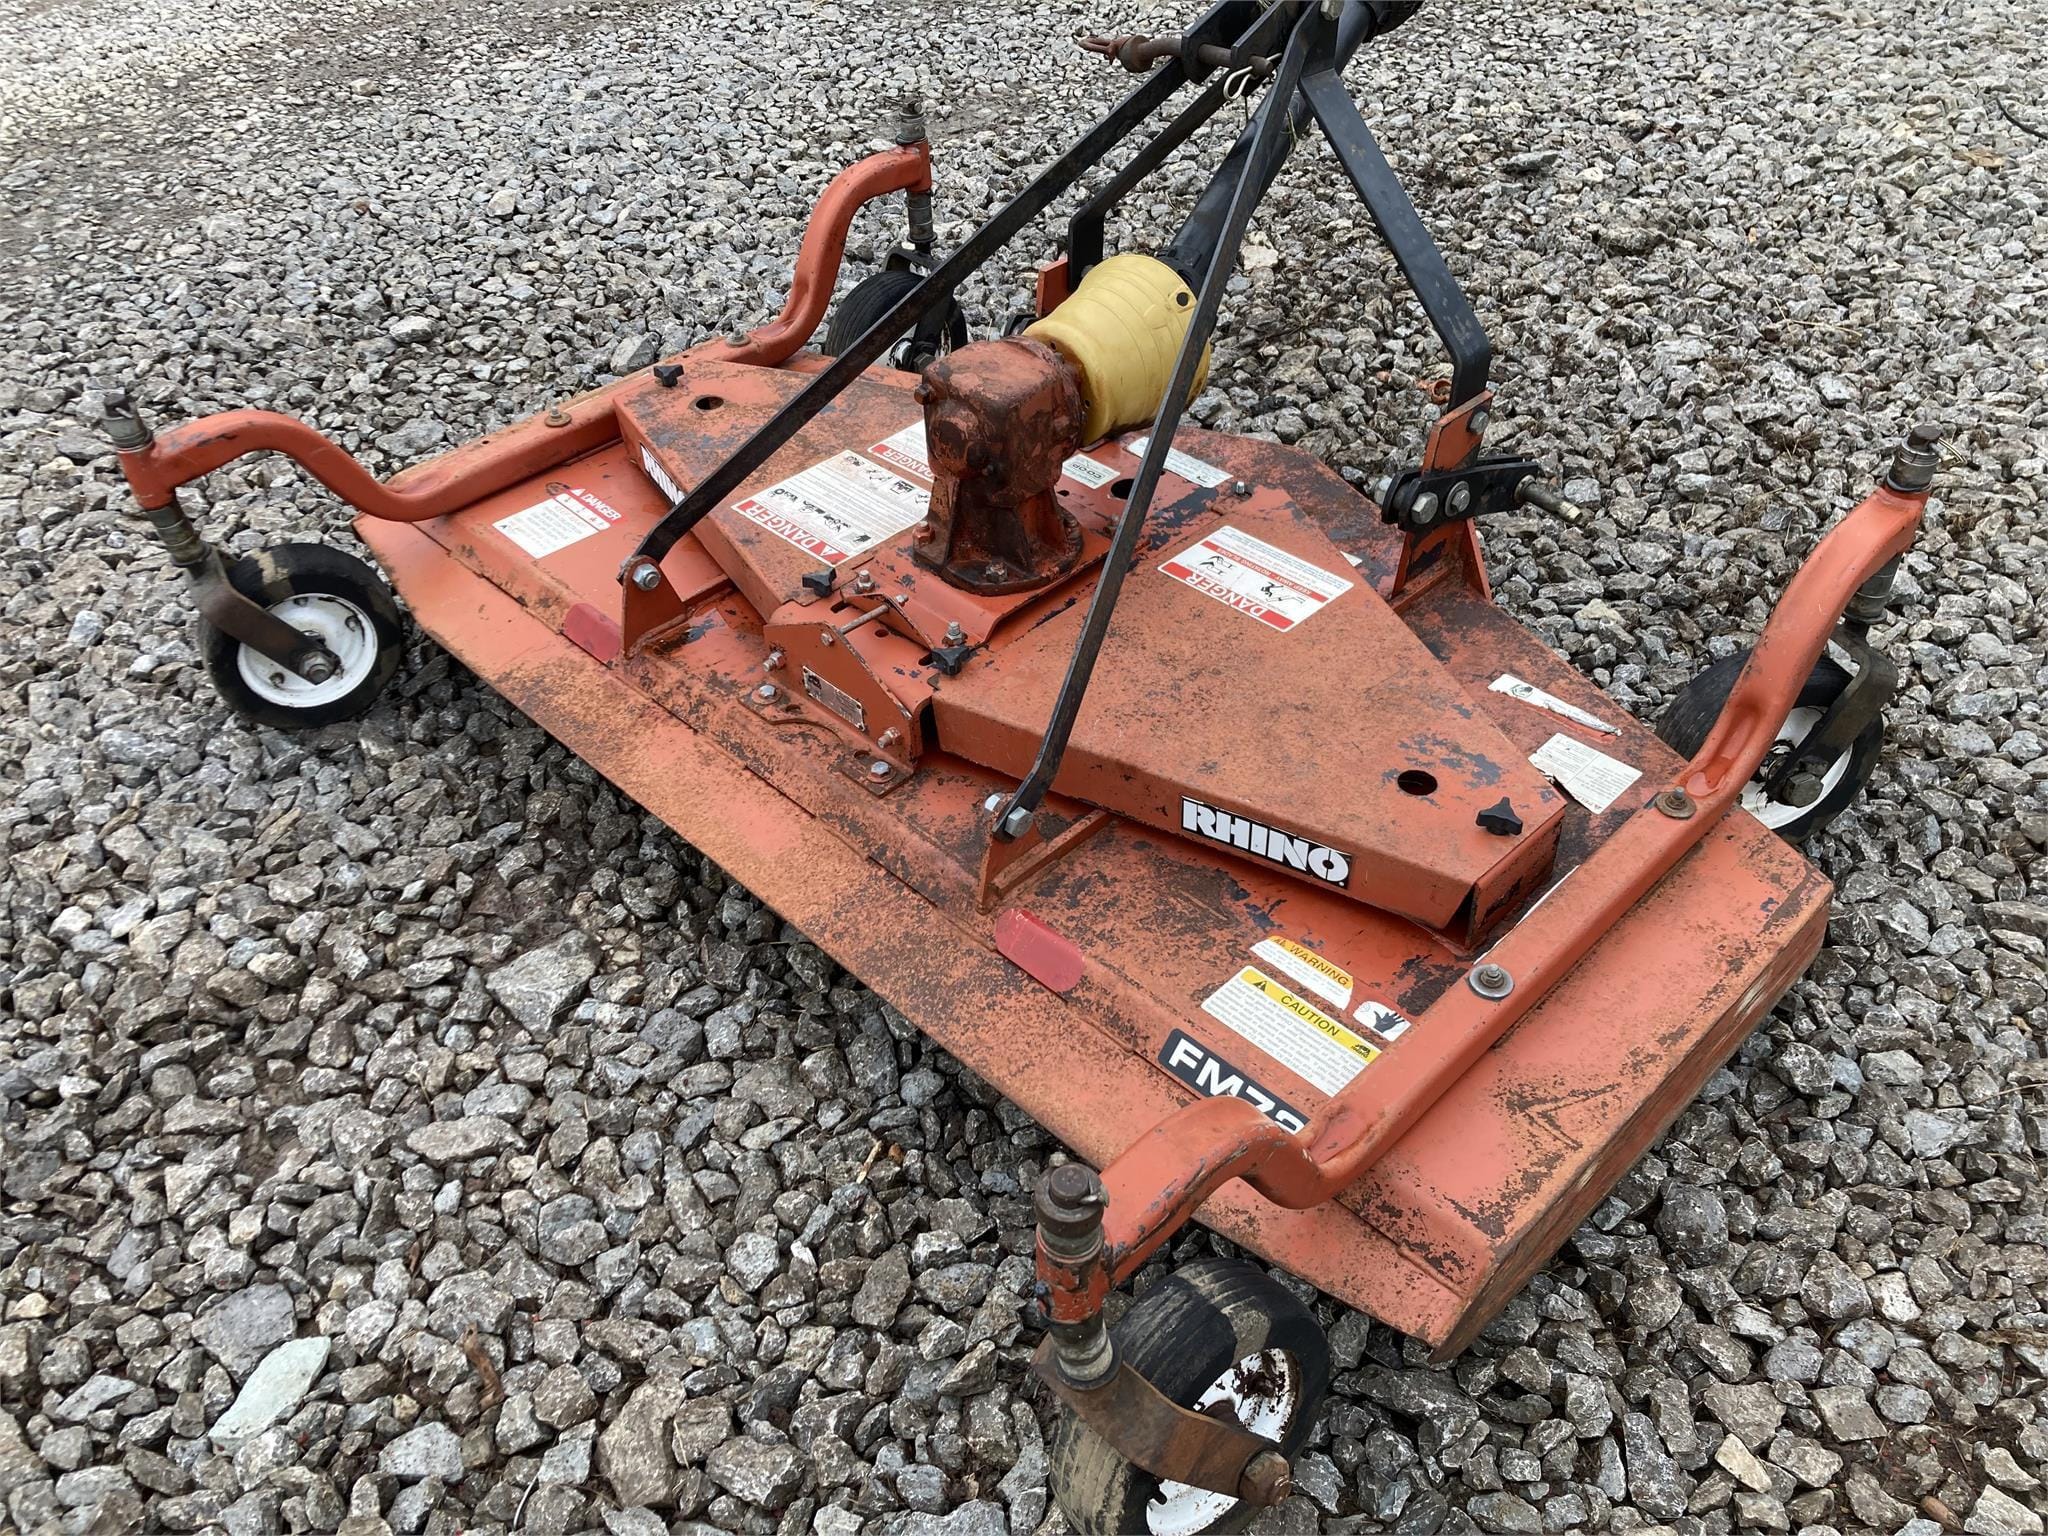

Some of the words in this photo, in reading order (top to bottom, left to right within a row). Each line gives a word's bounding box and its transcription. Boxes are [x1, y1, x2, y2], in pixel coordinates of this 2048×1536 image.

[581, 493, 622, 521] DANGER
[745, 502, 821, 549] DANGER
[1185, 571, 1266, 616] DANGER
[1183, 799, 1349, 883] RHINO
[1290, 945, 1349, 986] WARNING
[1280, 995, 1340, 1036] CAUTION
